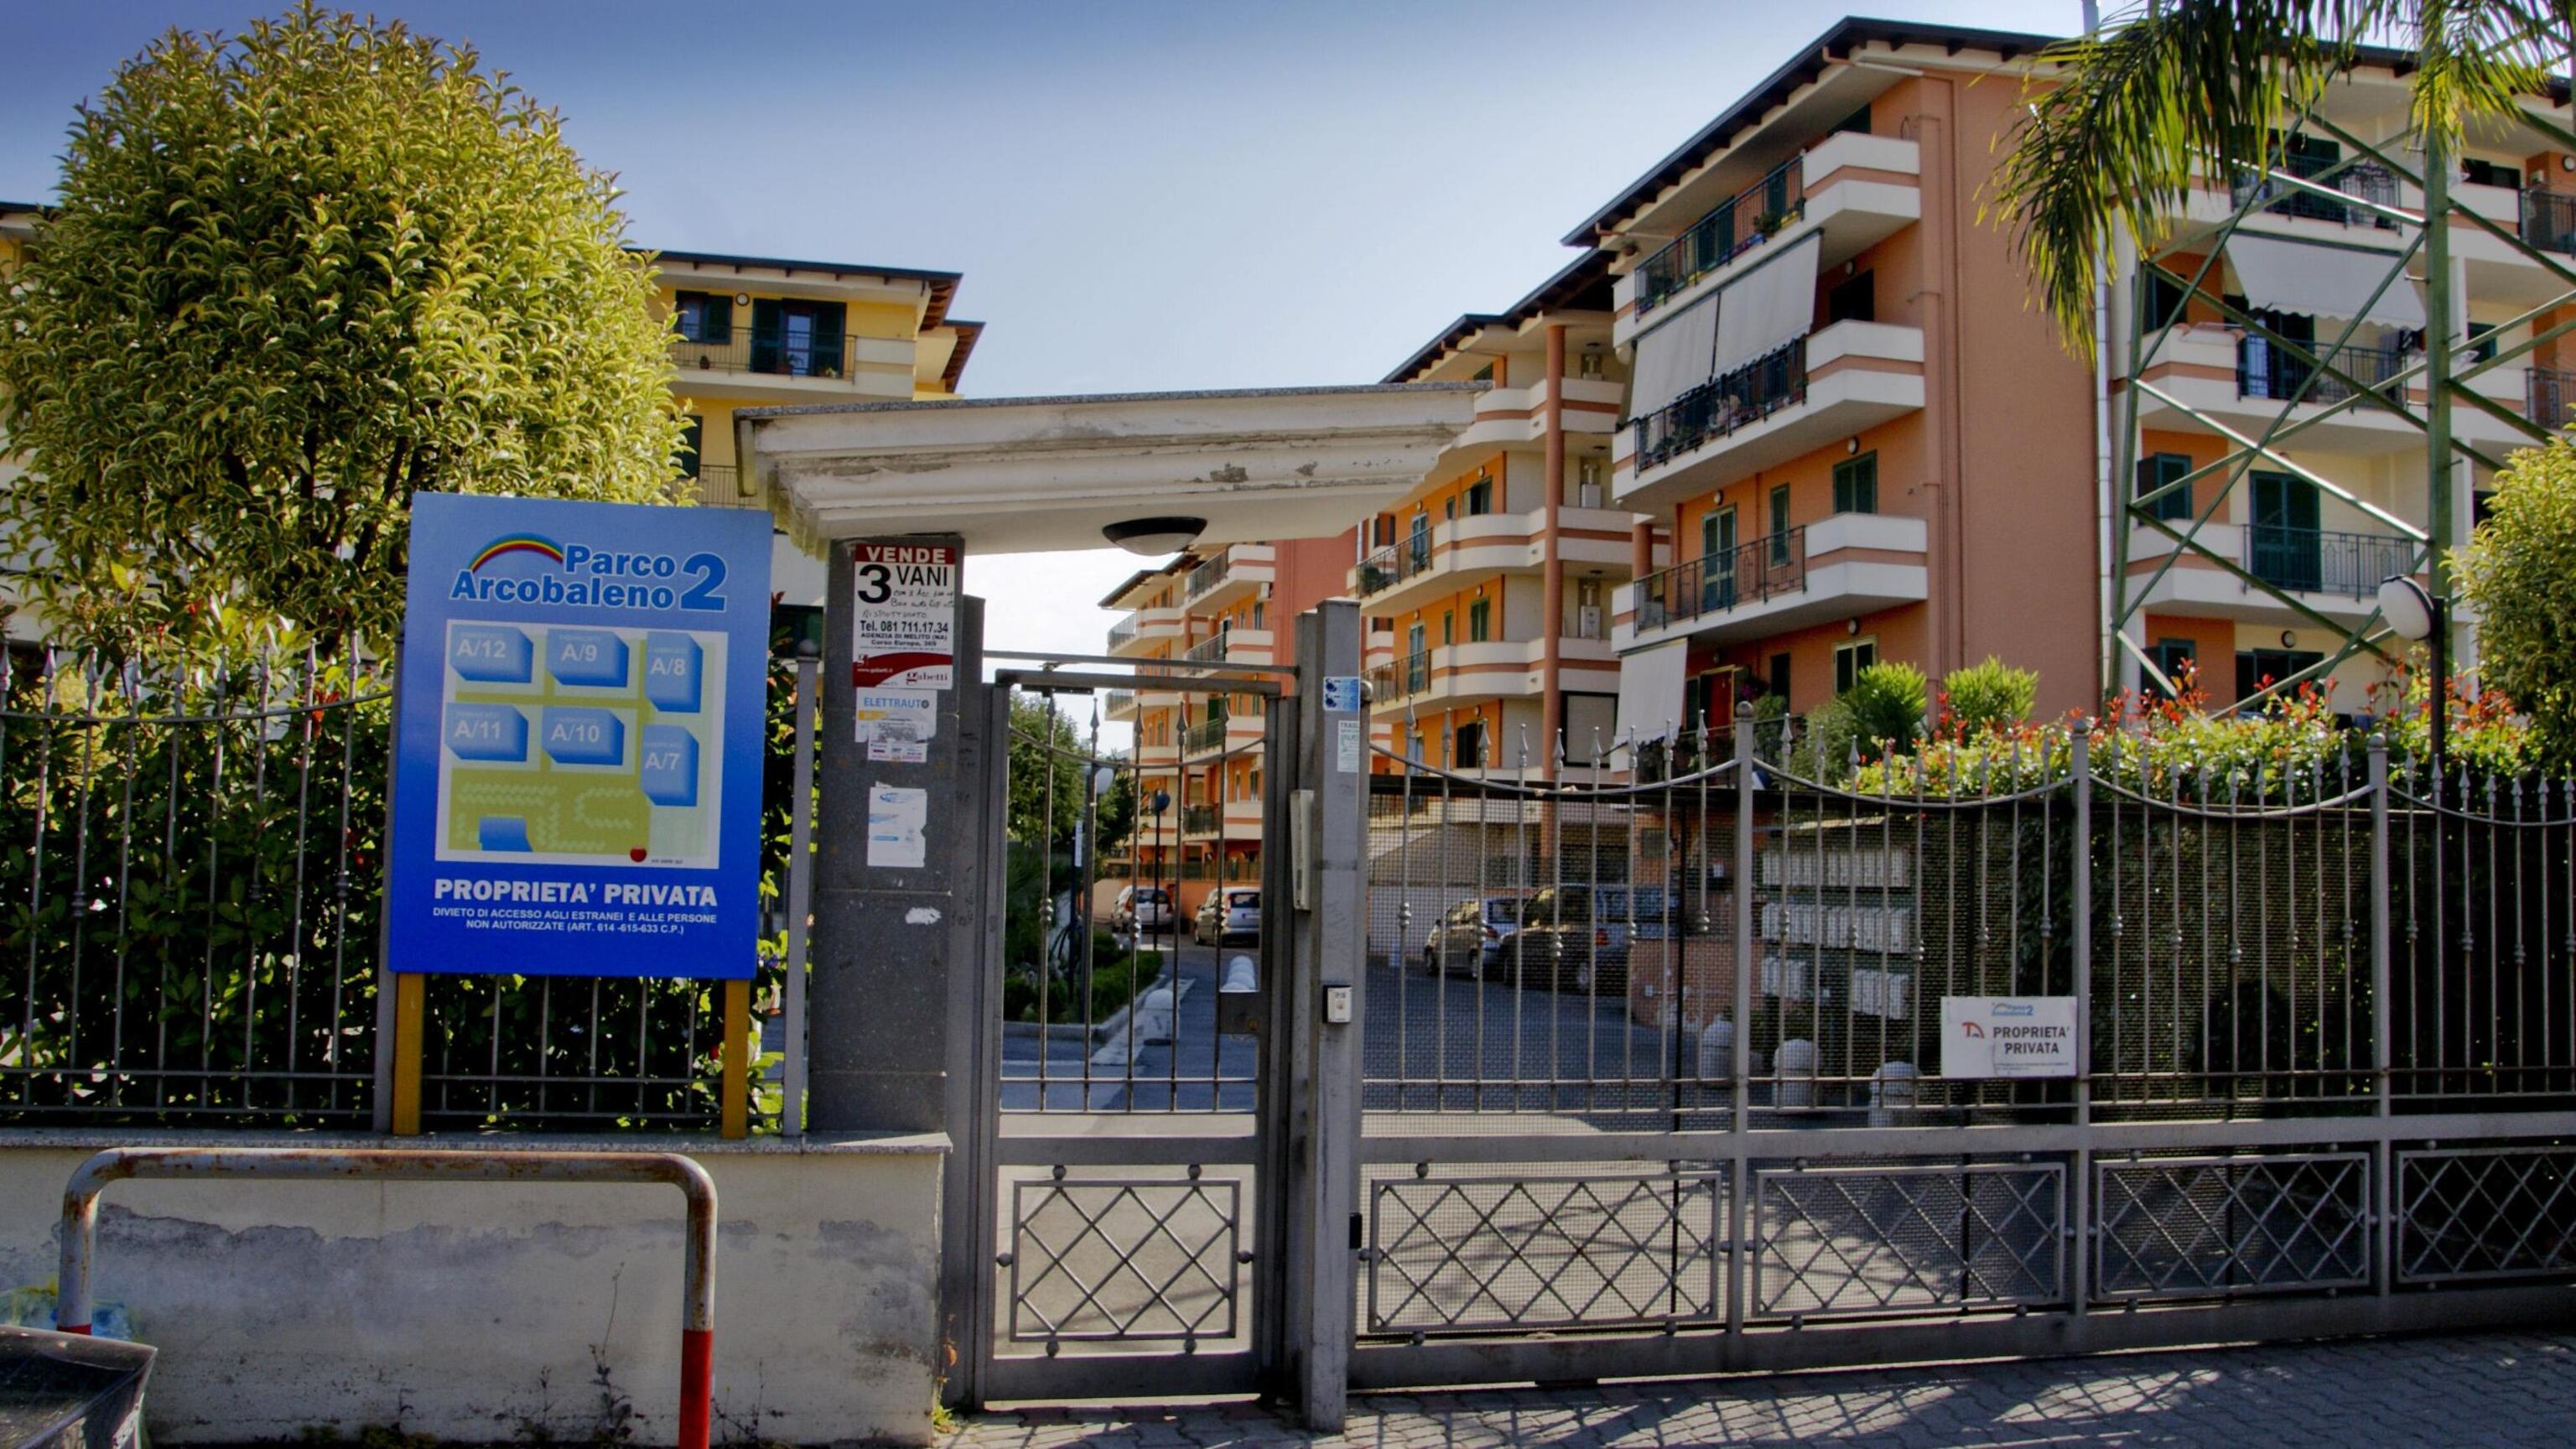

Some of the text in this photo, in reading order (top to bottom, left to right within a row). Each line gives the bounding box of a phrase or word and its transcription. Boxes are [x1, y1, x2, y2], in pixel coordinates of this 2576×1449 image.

[565, 543, 675, 578] Parco
[866, 547, 946, 564] VENDE
[449, 569, 674, 609] Arcobaleno
[680, 552, 728, 611] 2
[857, 564, 948, 604] 3 VANI
[860, 621, 948, 633] Tel. 081 711.17.34
[456, 639, 506, 658] A/12
[561, 643, 597, 662] A/9
[650, 657, 686, 676] A/8
[454, 719, 501, 740] A/11
[550, 723, 600, 742] A/10
[644, 751, 681, 770] A/7
[434, 879, 718, 906] PROPRIETA' PRIVATA
[433, 907, 717, 923] DIVIETO DI ACCESSO AGLI ESTRANEI E ALLE PERSONE
[466, 920, 489, 928] NON
[491, 920, 564, 931] AUTORIZZATE
[567, 922, 595, 932] (ART.
[661, 925, 684, 935] C.P.)
[1992, 1026, 2070, 1039] PROPRIETA'
[2004, 1042, 2059, 1054] PRIVATA
